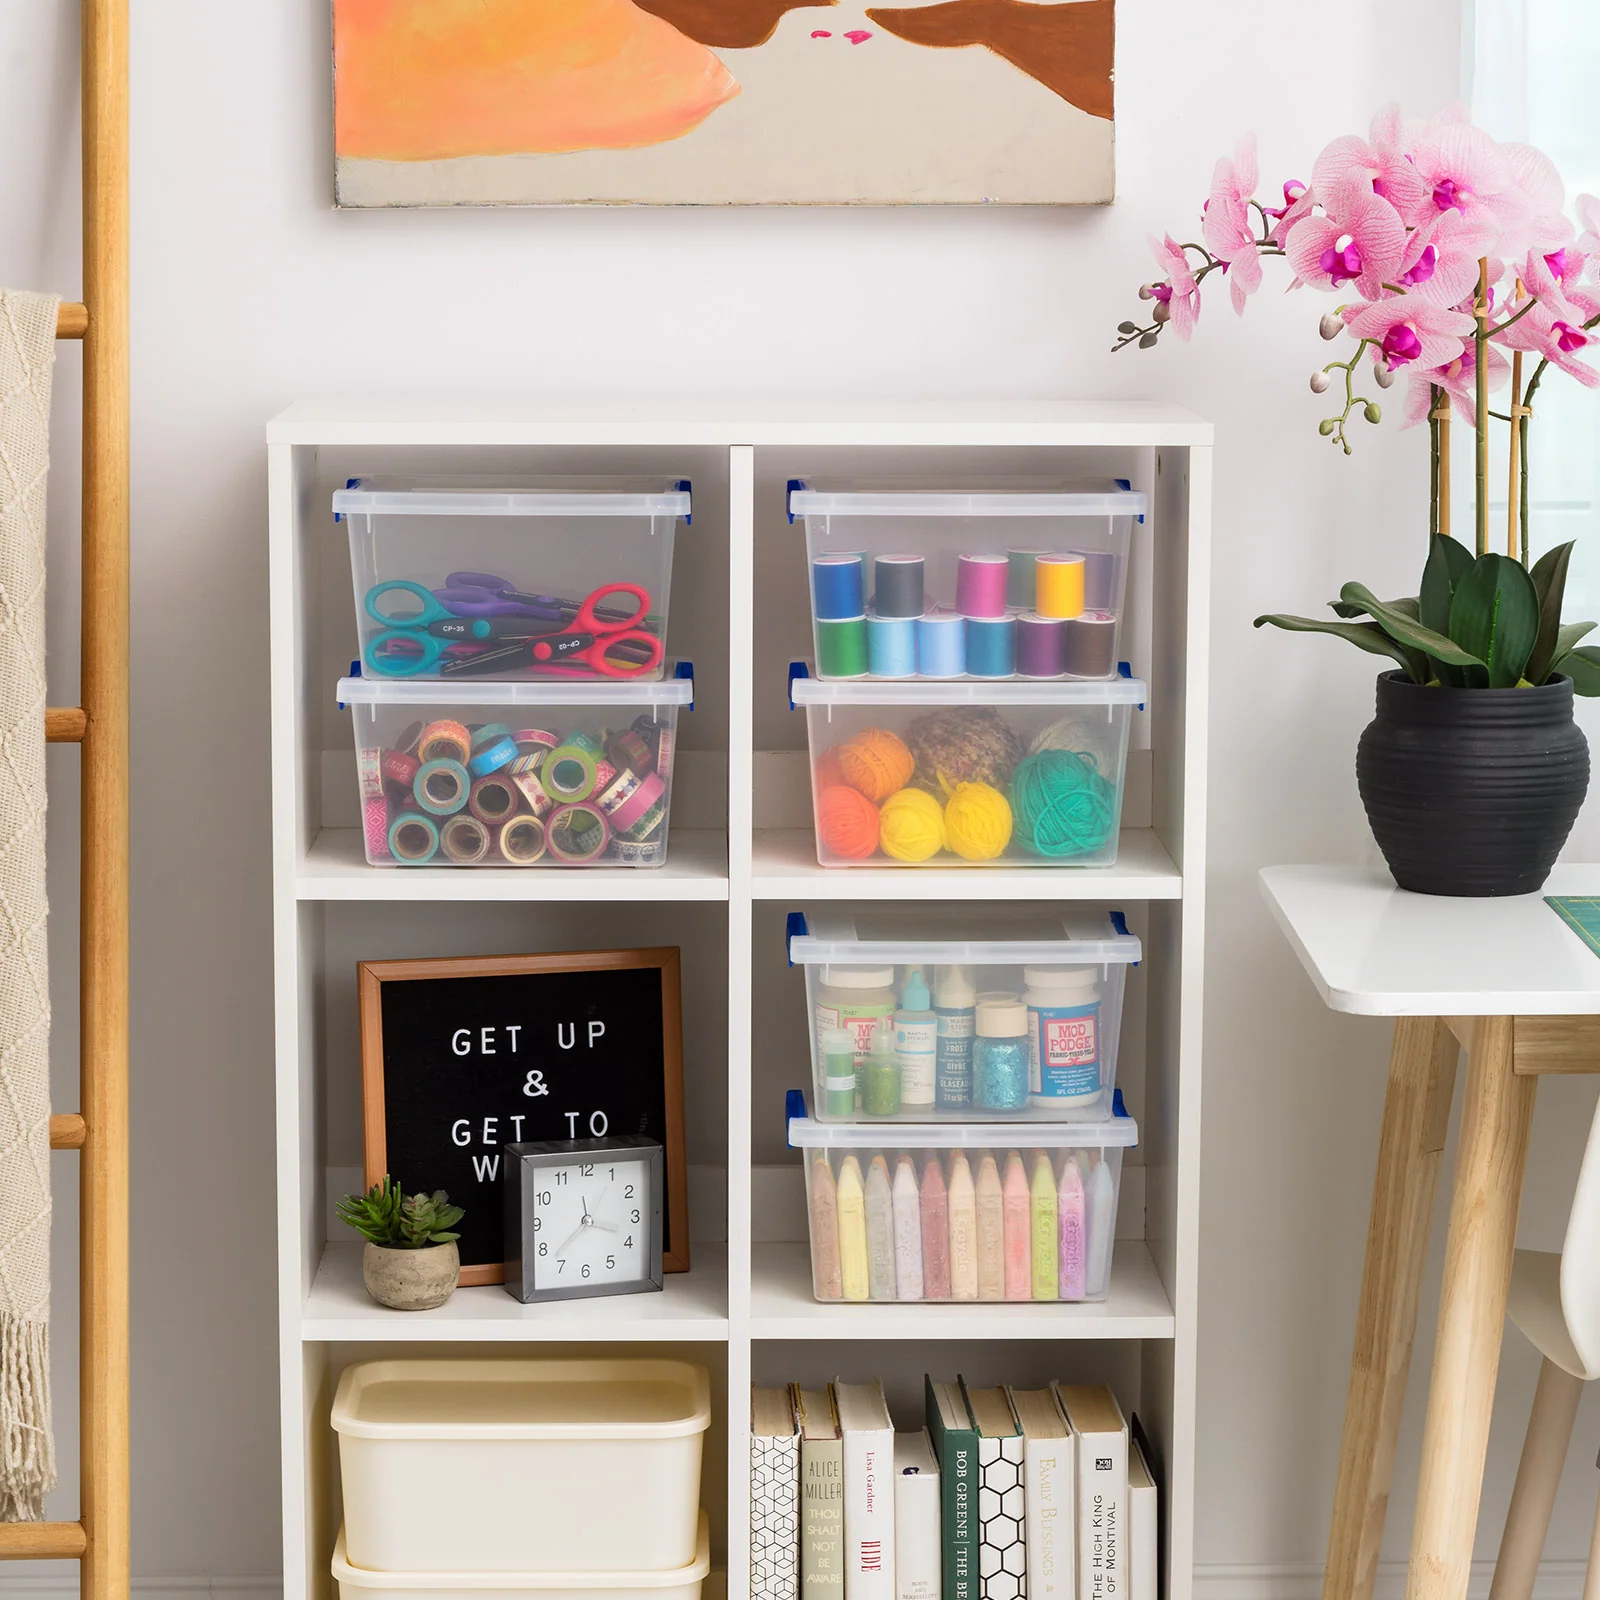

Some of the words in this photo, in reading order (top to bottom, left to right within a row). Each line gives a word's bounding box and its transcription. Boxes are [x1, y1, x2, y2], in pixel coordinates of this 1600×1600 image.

[558, 640, 580, 650] CP-02
[452, 1025, 522, 1056] GET
[558, 1021, 605, 1049] UP
[1058, 1024, 1086, 1038] MOD
[1050, 1036, 1091, 1051] PODGE
[523, 1070, 550, 1096] &
[452, 1115, 526, 1146] GET
[565, 1111, 608, 1139] TO
[579, 1164, 594, 1176] 12
[609, 1168, 614, 1181] 1
[555, 1172, 568, 1185] 11
[536, 1191, 551, 1206] 10
[624, 1185, 634, 1198] 2
[534, 1218, 542, 1231] 9
[631, 1210, 640, 1224] 3
[539, 1242, 548, 1256] 8
[624, 1236, 633, 1248] 4
[955, 1216, 970, 1273] Crayola
[1063, 1214, 1081, 1276] Crayola
[557, 1260, 566, 1274] 7
[606, 1255, 615, 1269] 5
[581, 1264, 590, 1278] 6
[809, 1461, 839, 1477] ALICE
[866, 1452, 875, 1471] Lisa
[956, 1450, 967, 1478] BOB
[806, 1482, 842, 1500] MILLER
[866, 1474, 875, 1513] Gardner
[809, 1508, 840, 1519] THOU
[956, 1482, 968, 1538] GREENE
[1093, 1494, 1102, 1528] KING
[808, 1525, 840, 1535] SHALT
[1106, 1502, 1116, 1570] MONTIVAL
[812, 1542, 836, 1552] NOT
[1093, 1534, 1102, 1568] HIGH
[818, 1558, 830, 1568] BE
[861, 1541, 881, 1572] HIDE
[956, 1548, 968, 1576] THE
[806, 1573, 842, 1584] AWARE
[1107, 1576, 1116, 1592] OF
[956, 1582, 968, 1600] BE
[1093, 1574, 1102, 1600] THE
